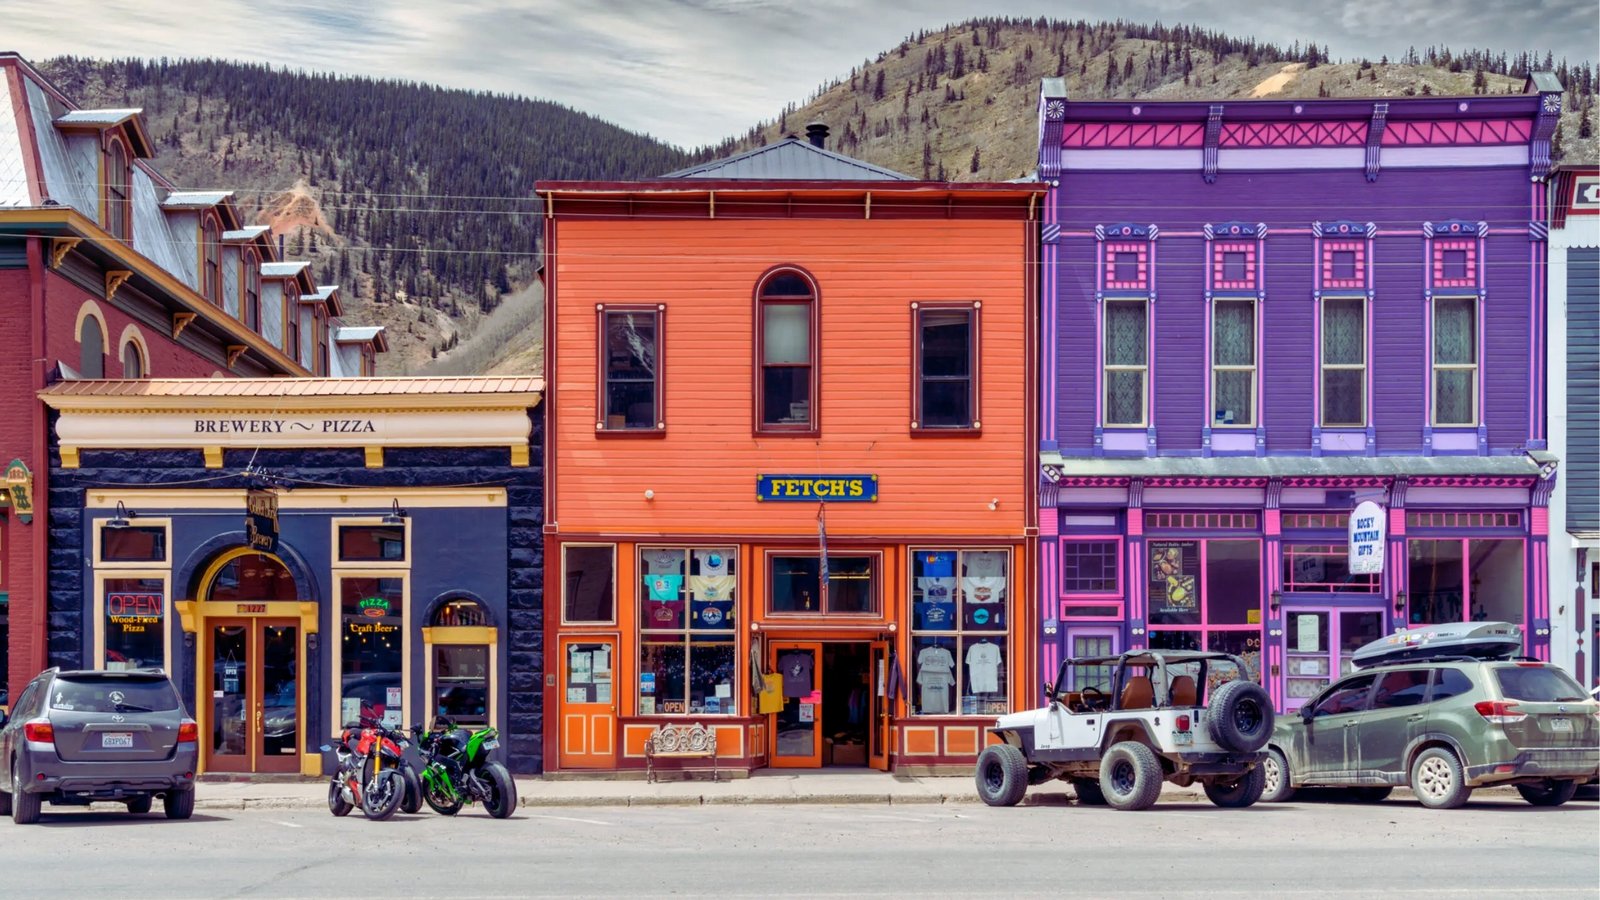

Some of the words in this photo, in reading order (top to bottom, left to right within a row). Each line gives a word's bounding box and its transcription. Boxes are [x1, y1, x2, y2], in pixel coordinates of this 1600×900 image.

[194, 420, 285, 433] BREWERY
[322, 420, 376, 433] PIZZA
[771, 479, 863, 496] FETCH'S
[1357, 517, 1374, 530] ROCKY
[1353, 530, 1379, 543] MOUNTAIN
[1358, 545, 1373, 556] GIFTS
[110, 595, 161, 615] OPEN
[360, 598, 388, 609] PIZZA
[123, 624, 145, 632] Pizza
[350, 624, 372, 632] Craft
[375, 624, 393, 632] Beer
[664, 702, 685, 712] OPEN
[986, 702, 1007, 713] OPEN
